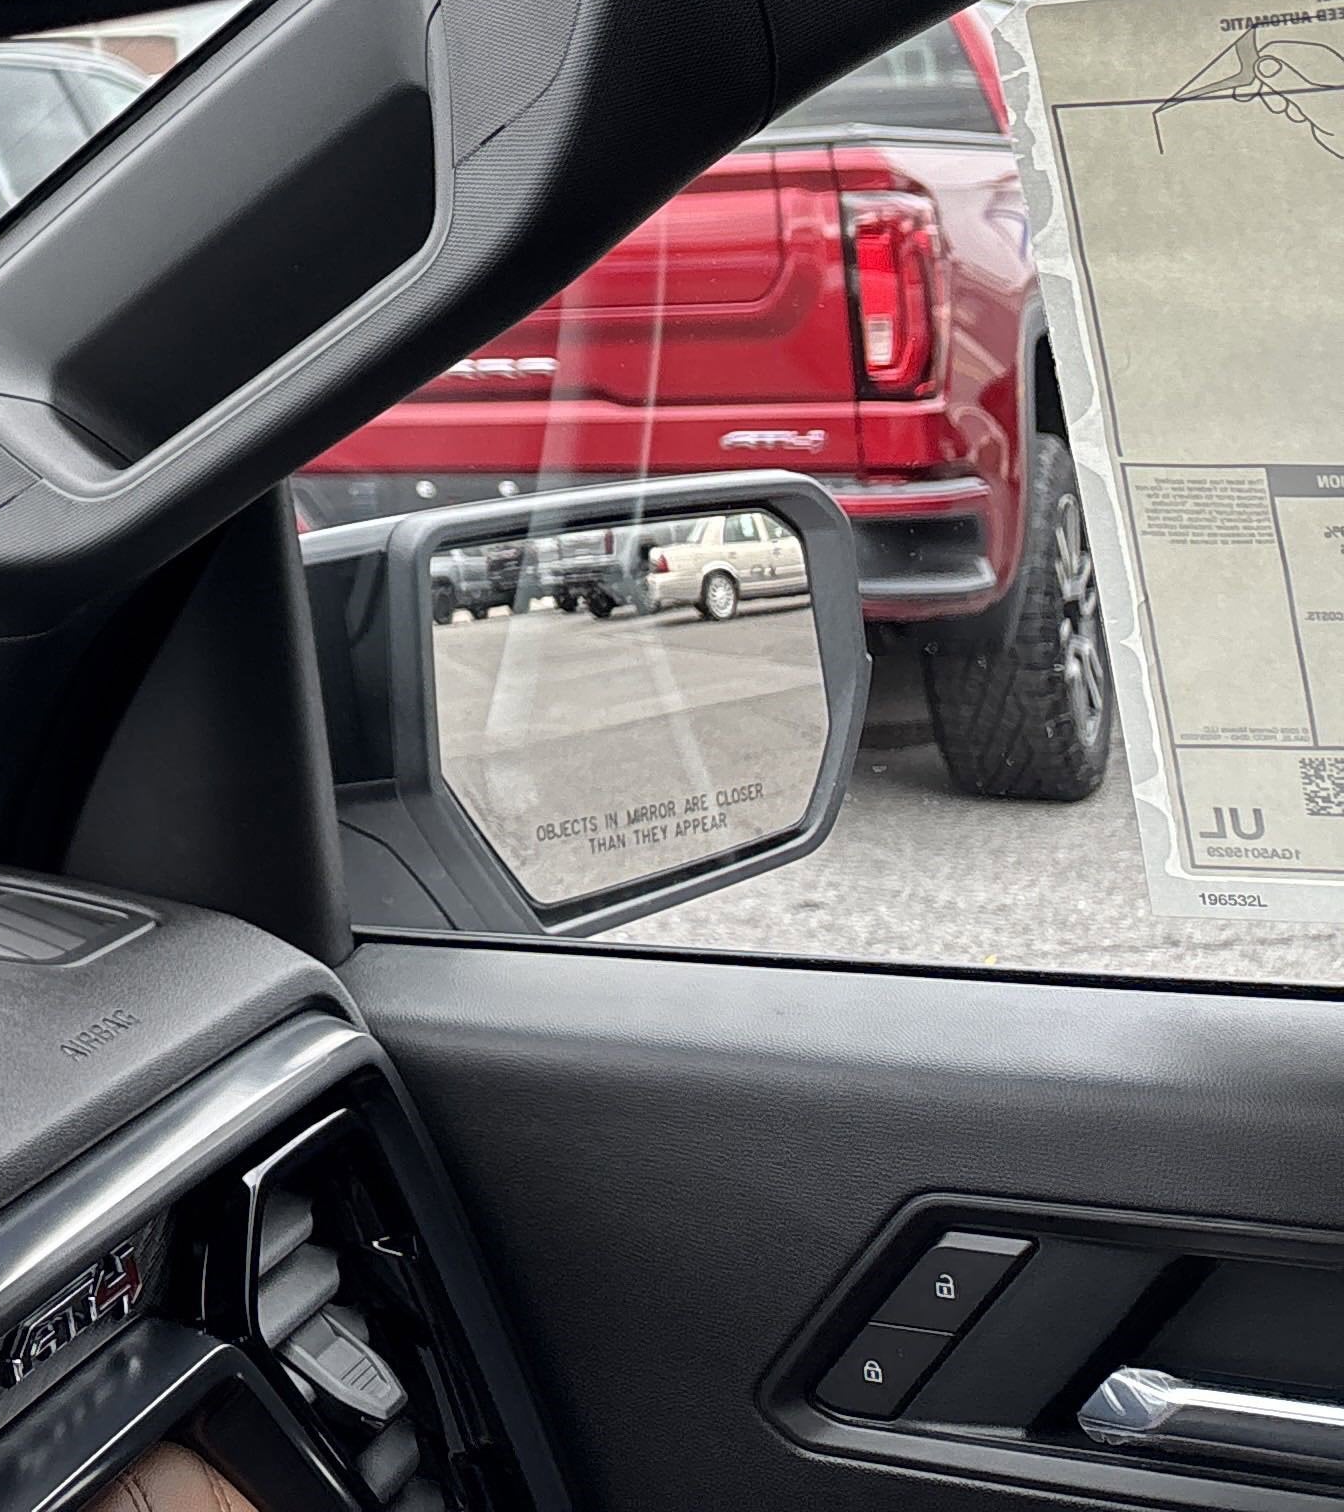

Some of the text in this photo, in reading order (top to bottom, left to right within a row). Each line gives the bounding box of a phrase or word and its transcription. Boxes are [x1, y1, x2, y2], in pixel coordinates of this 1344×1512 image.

[536, 782, 764, 842] OBJECTS IN MIRROR ARE CLOSER
[588, 812, 728, 855] THAN THEY APPEAR
[1198, 892, 1269, 908] 196532L
[59, 1008, 142, 1063] AIRBAG
